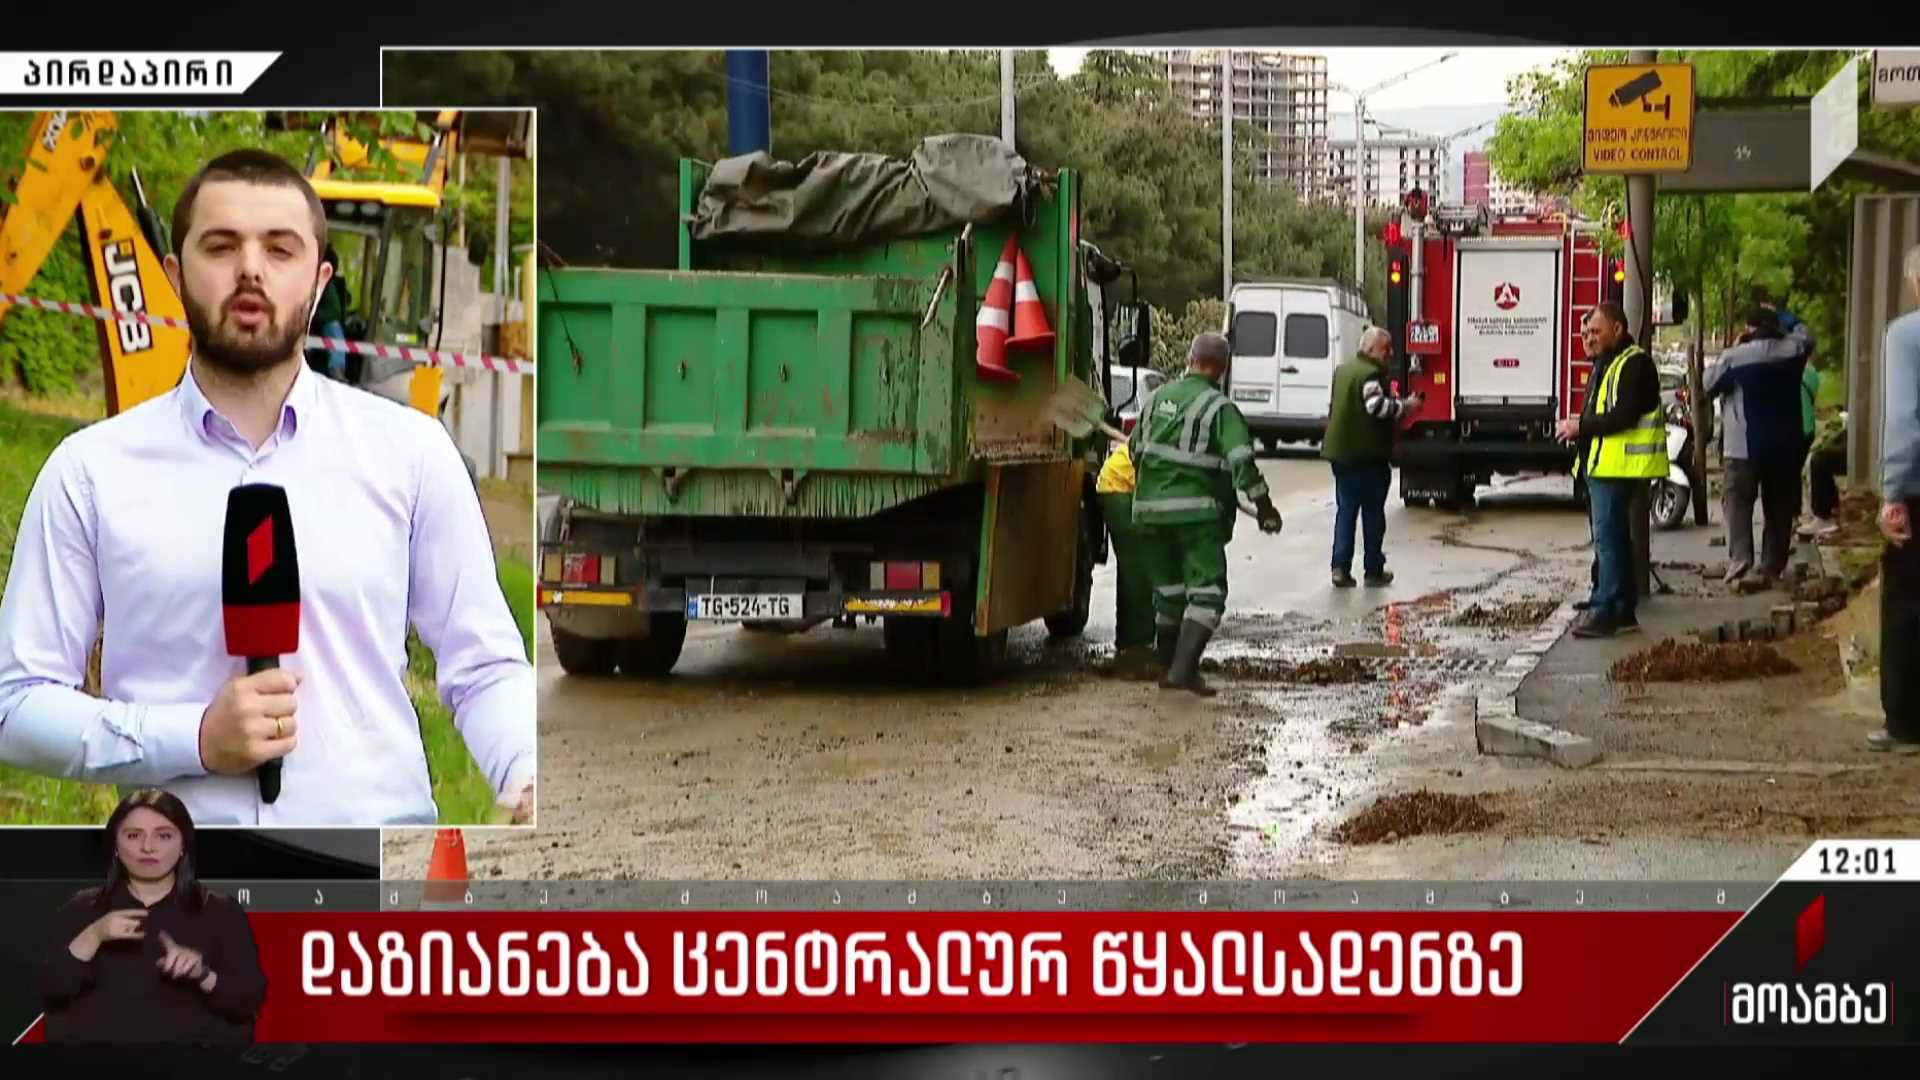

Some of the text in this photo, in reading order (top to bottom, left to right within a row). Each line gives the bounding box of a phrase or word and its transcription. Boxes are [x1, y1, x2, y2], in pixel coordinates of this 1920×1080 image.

[1593, 148, 1681, 161] VIDEO CONTROL
[103, 242, 152, 354] JCB
